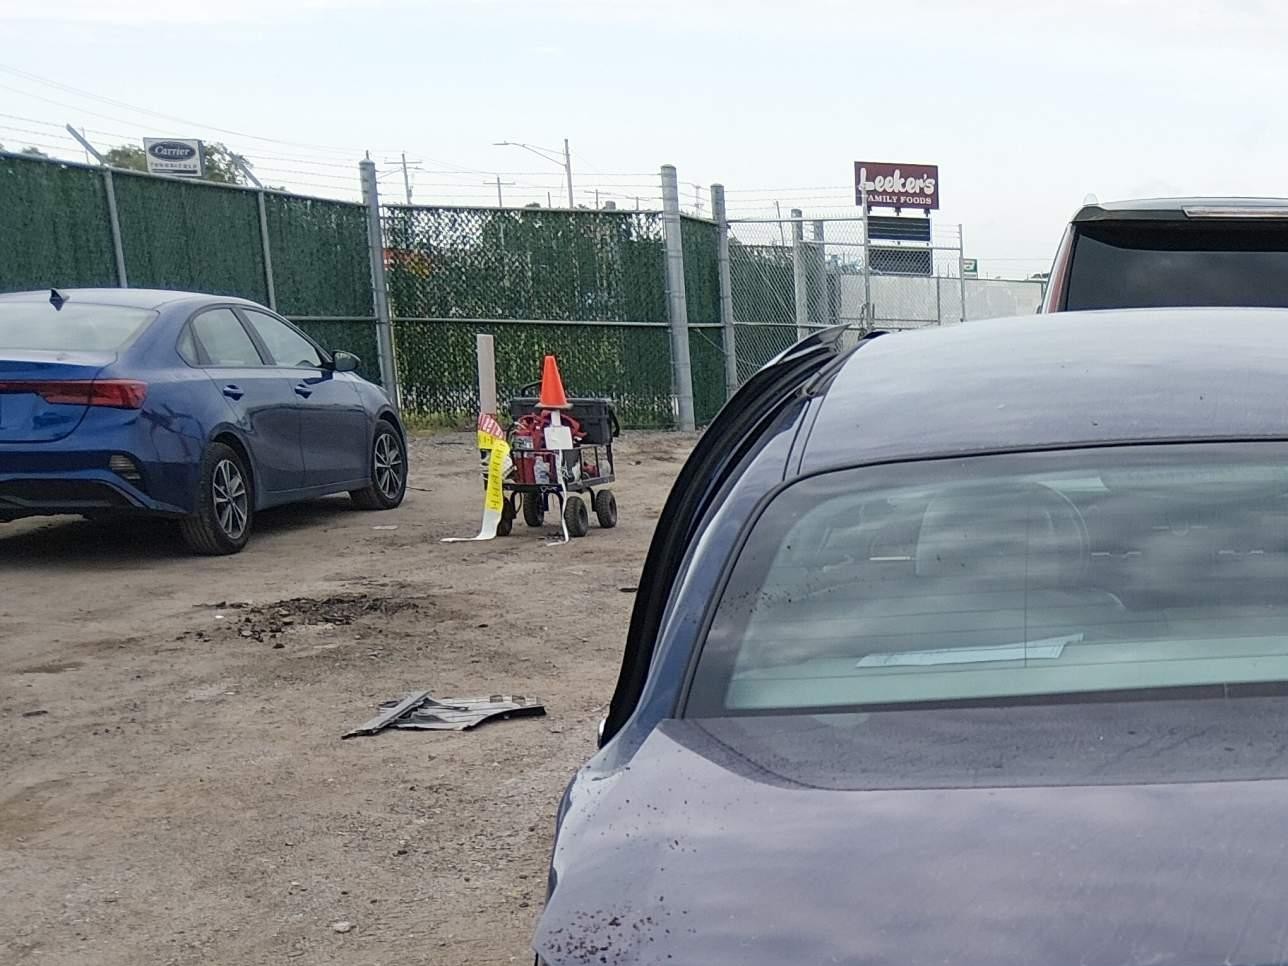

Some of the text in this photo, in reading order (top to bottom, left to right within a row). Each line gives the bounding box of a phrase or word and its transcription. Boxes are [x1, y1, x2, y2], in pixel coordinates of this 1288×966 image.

[154, 145, 191, 156] Carrier
[858, 167, 936, 195] Leeker's
[864, 194, 932, 204] AMILY FOODS
